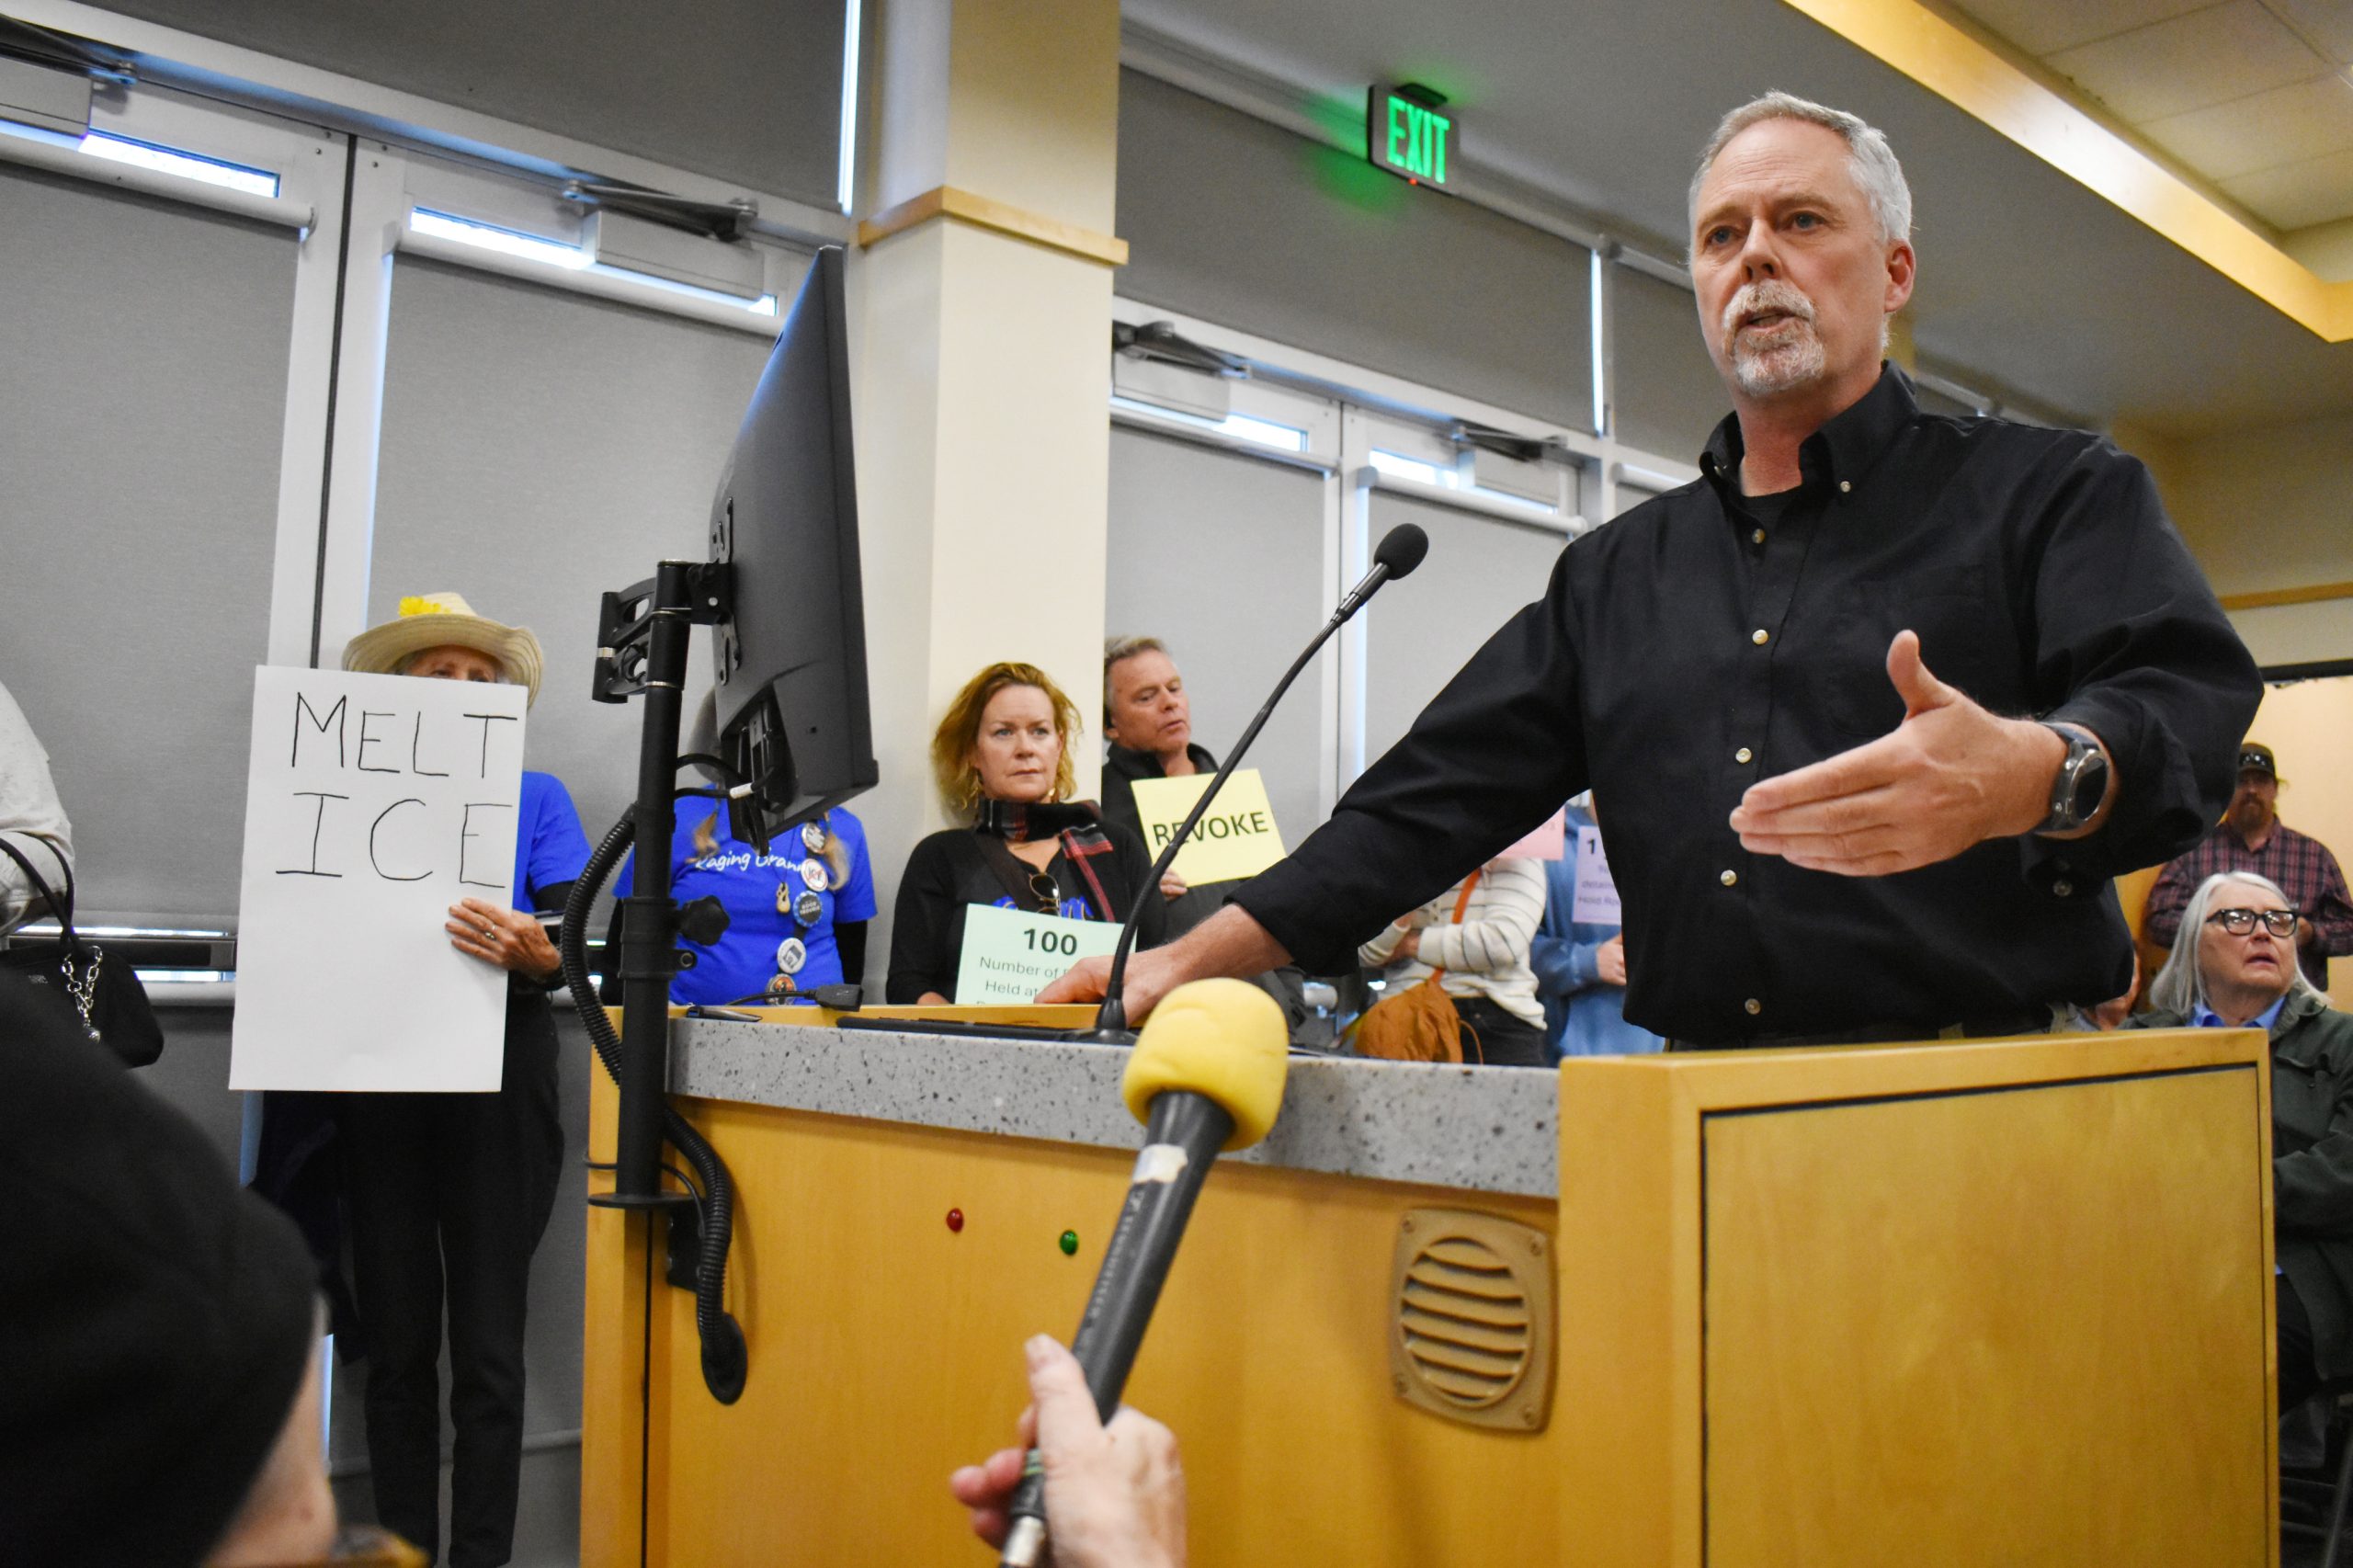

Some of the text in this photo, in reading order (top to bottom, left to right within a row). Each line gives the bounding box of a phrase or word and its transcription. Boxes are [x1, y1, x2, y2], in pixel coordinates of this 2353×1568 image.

[1387, 96, 1450, 184] EXIT
[292, 692, 518, 779] MELT
[276, 792, 513, 889] ICE
[980, 957, 1040, 976] Number
[1044, 968, 1060, 978] of
[1024, 928, 1077, 956] 100
[985, 981, 1039, 996] Held at
